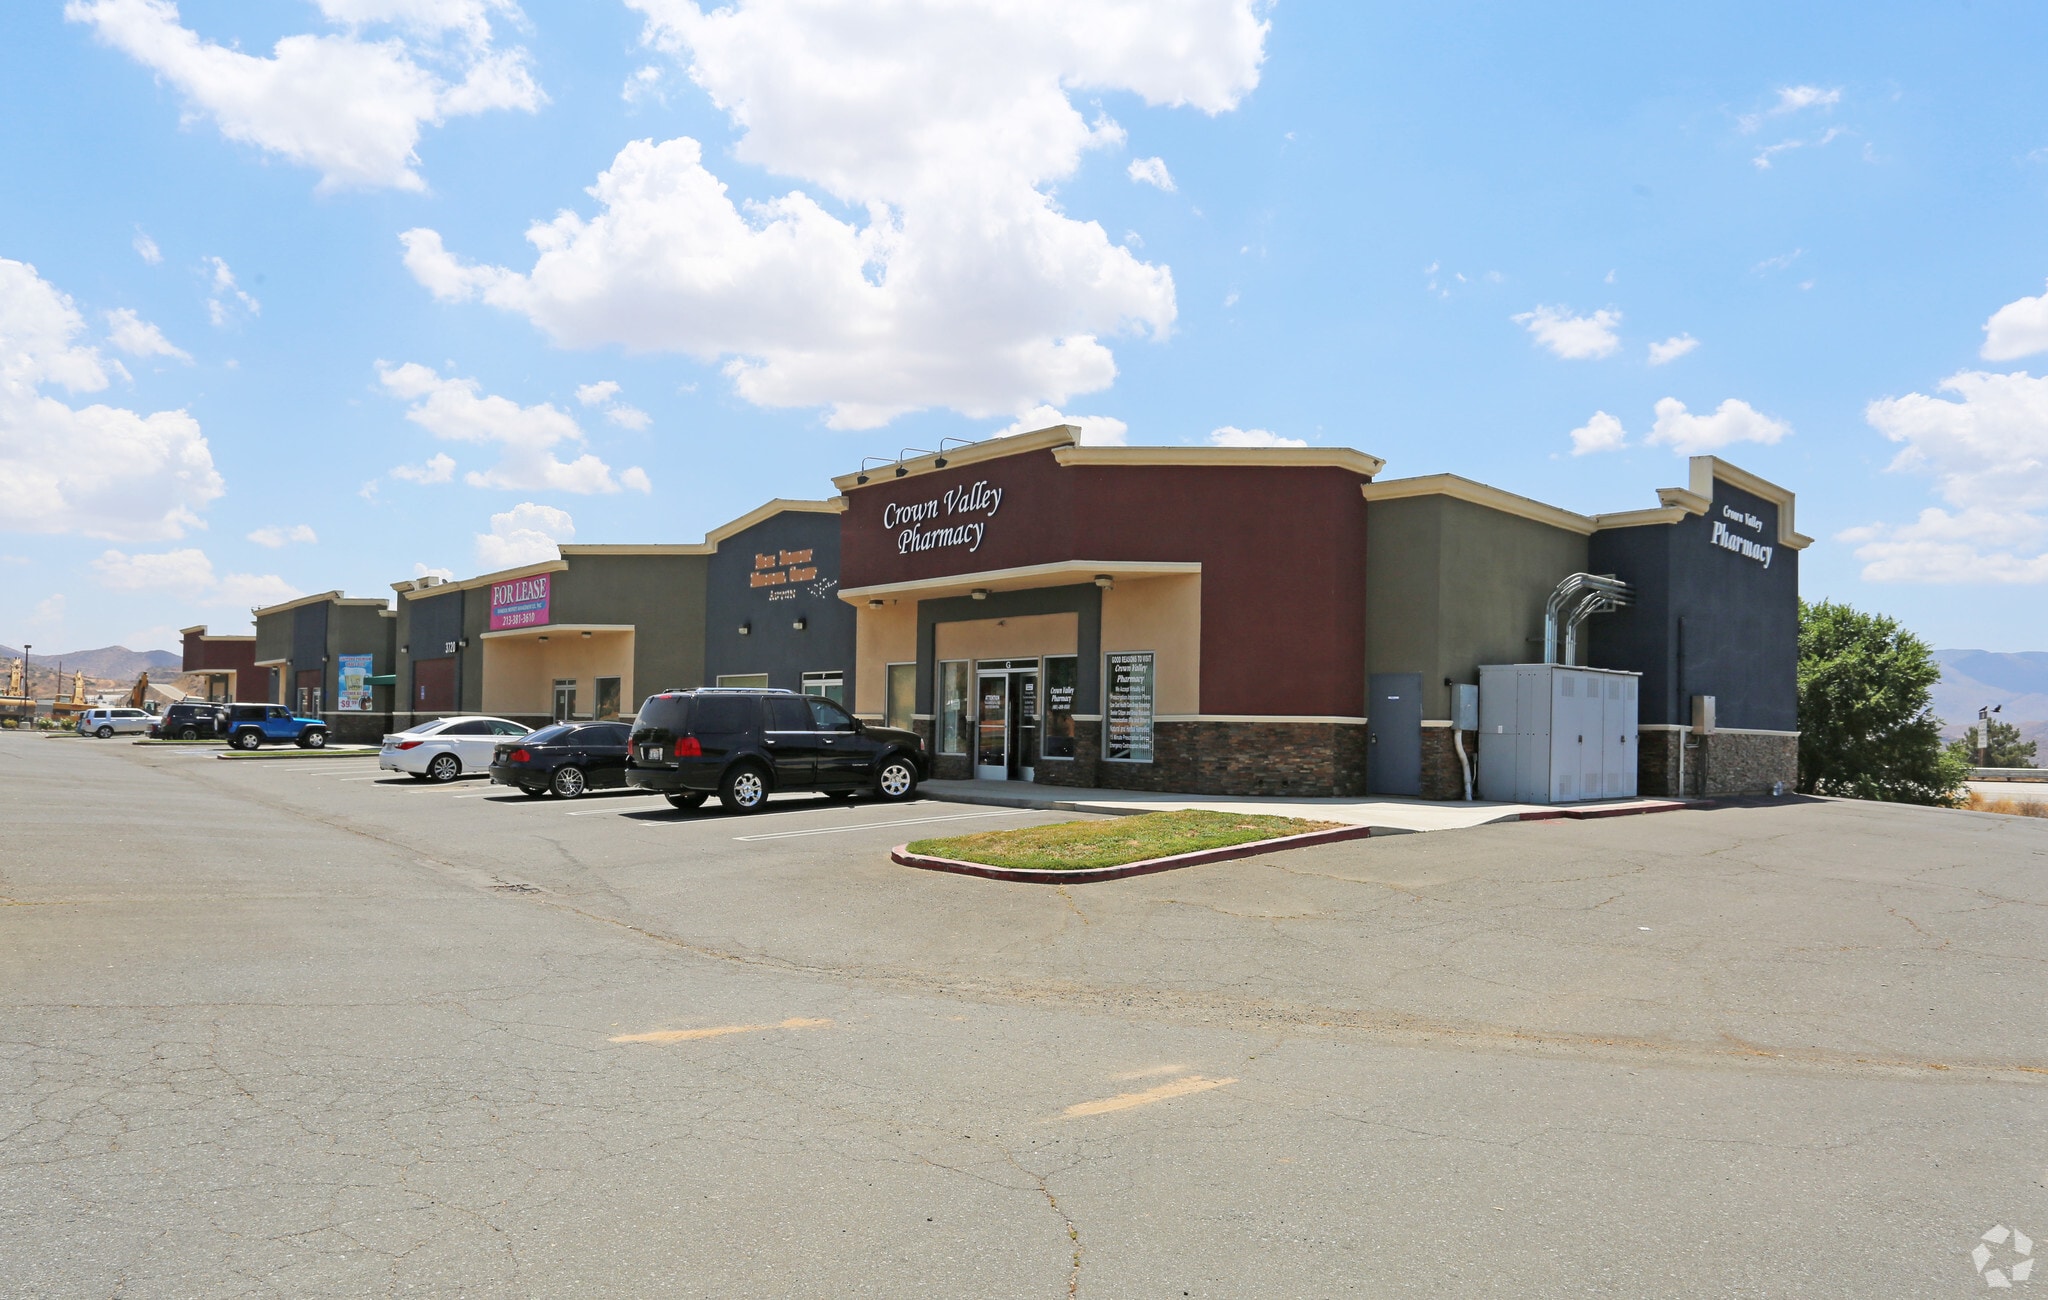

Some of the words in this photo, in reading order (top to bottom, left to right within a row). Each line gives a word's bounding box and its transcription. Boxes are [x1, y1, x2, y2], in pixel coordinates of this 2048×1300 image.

[884, 502, 938, 529] Crown
[944, 481, 1002, 517] Valley
[1723, 505, 1744, 523] Crown
[1745, 512, 1763, 533] Valley
[898, 522, 984, 554] Pharmacy
[1710, 521, 1773, 569] Pharmacy
[493, 584, 514, 606] FOR
[516, 578, 546, 602] LEASE
[502, 612, 535, 626] 213-381-3610
[445, 641, 456, 654] 3720
[1006, 661, 1011, 669] G
[1115, 664, 1131, 672] Crown
[1131, 663, 1147, 674] Valley
[1116, 675, 1145, 684] Pharmacy
[1063, 686, 1074, 695] Valley
[1051, 695, 1072, 703] Pharmacy
